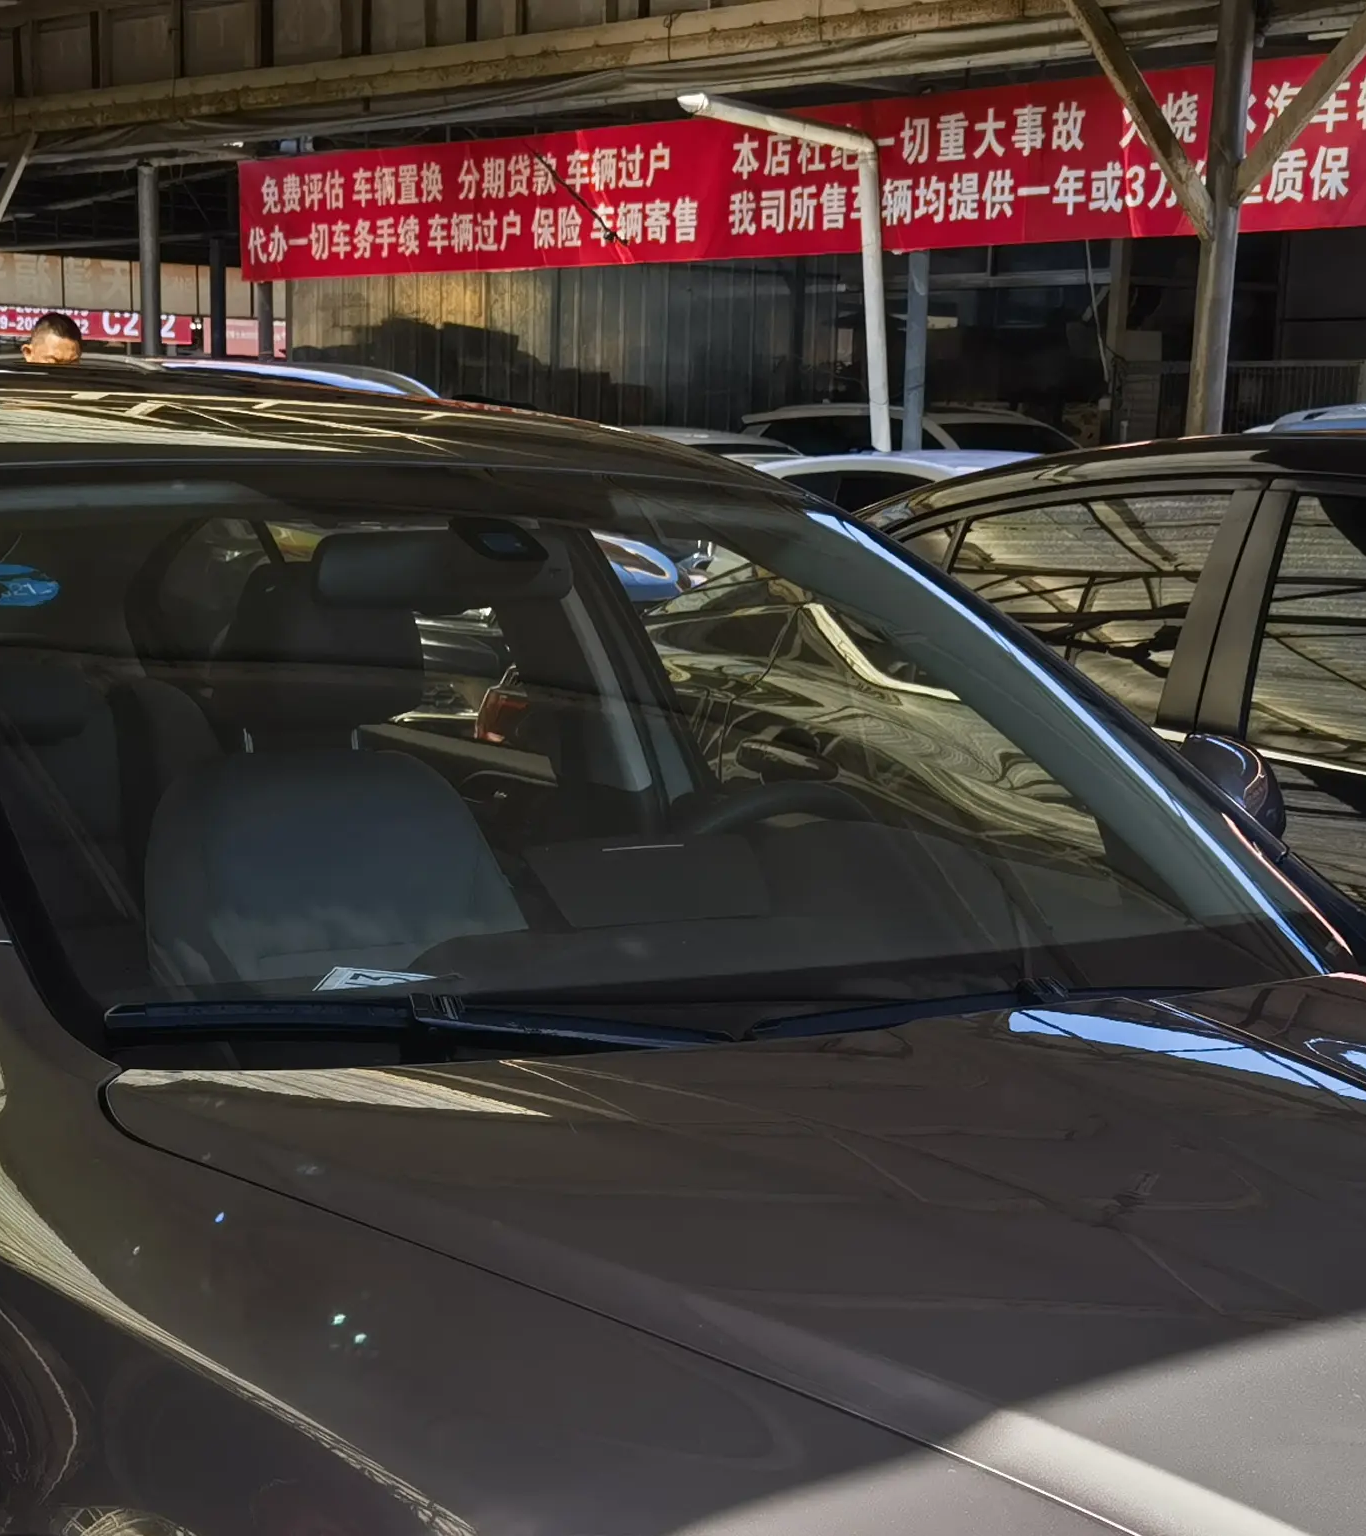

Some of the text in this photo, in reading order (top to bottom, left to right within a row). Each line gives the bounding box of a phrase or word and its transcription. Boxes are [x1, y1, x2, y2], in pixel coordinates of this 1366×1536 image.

[261, 141, 671, 215] 免费评估 车辆置换 分期贷款 车辆过户
[248, 195, 699, 265] 代办一切车务手续 车辆过户 保险 车辆寄售
[102, 311, 176, 338] C22
